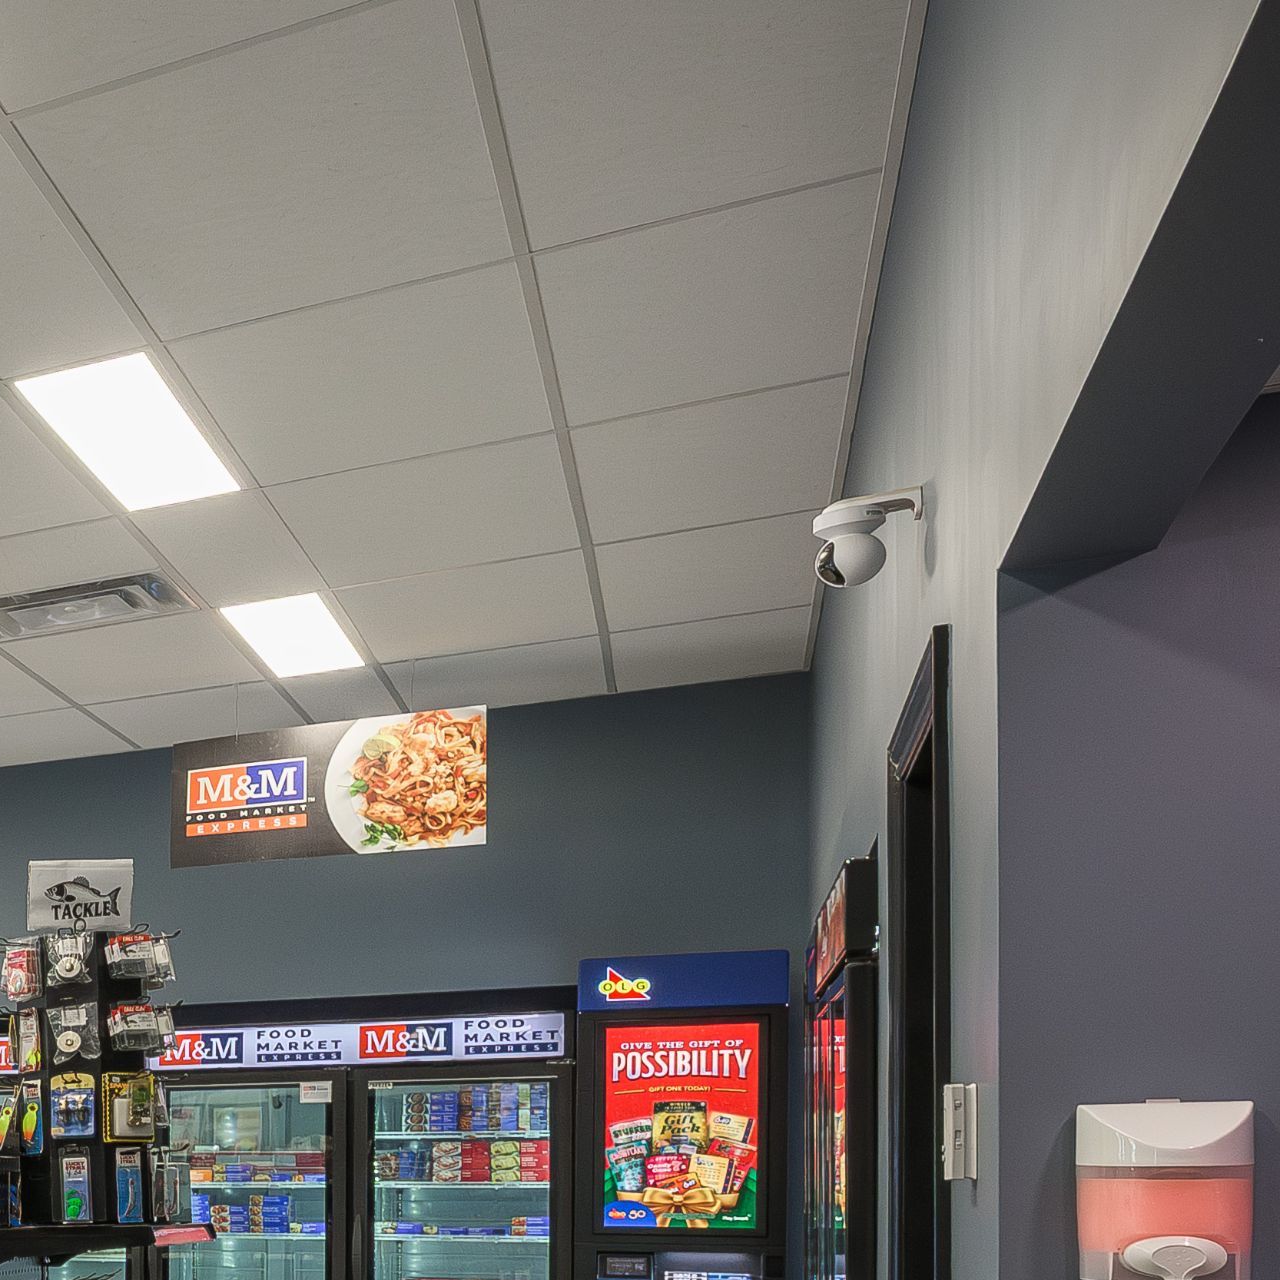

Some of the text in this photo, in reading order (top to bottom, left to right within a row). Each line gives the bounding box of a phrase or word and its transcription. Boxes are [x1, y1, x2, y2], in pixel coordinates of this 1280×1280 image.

[196, 767, 298, 805] M&M
[186, 804, 307, 822] FOOD MARKET
[197, 817, 298, 834] EXPRESS
[51, 900, 112, 921] TACKLE
[464, 1018, 525, 1030] FOOD
[256, 1028, 312, 1039] FOOD
[364, 1026, 447, 1053] M&M
[464, 1030, 559, 1043] MARKET
[165, 1036, 239, 1062] M&M
[256, 1039, 343, 1052] MARKET
[468, 1044, 555, 1053] EXPRESS
[620, 1039, 744, 1050] GIVE THE GIFT OF
[260, 1053, 339, 1062] EXPRESS
[612, 1049, 752, 1082] POSSIBILITY
[664, 1114, 694, 1125] Gift
[660, 1124, 701, 1135] Pack
